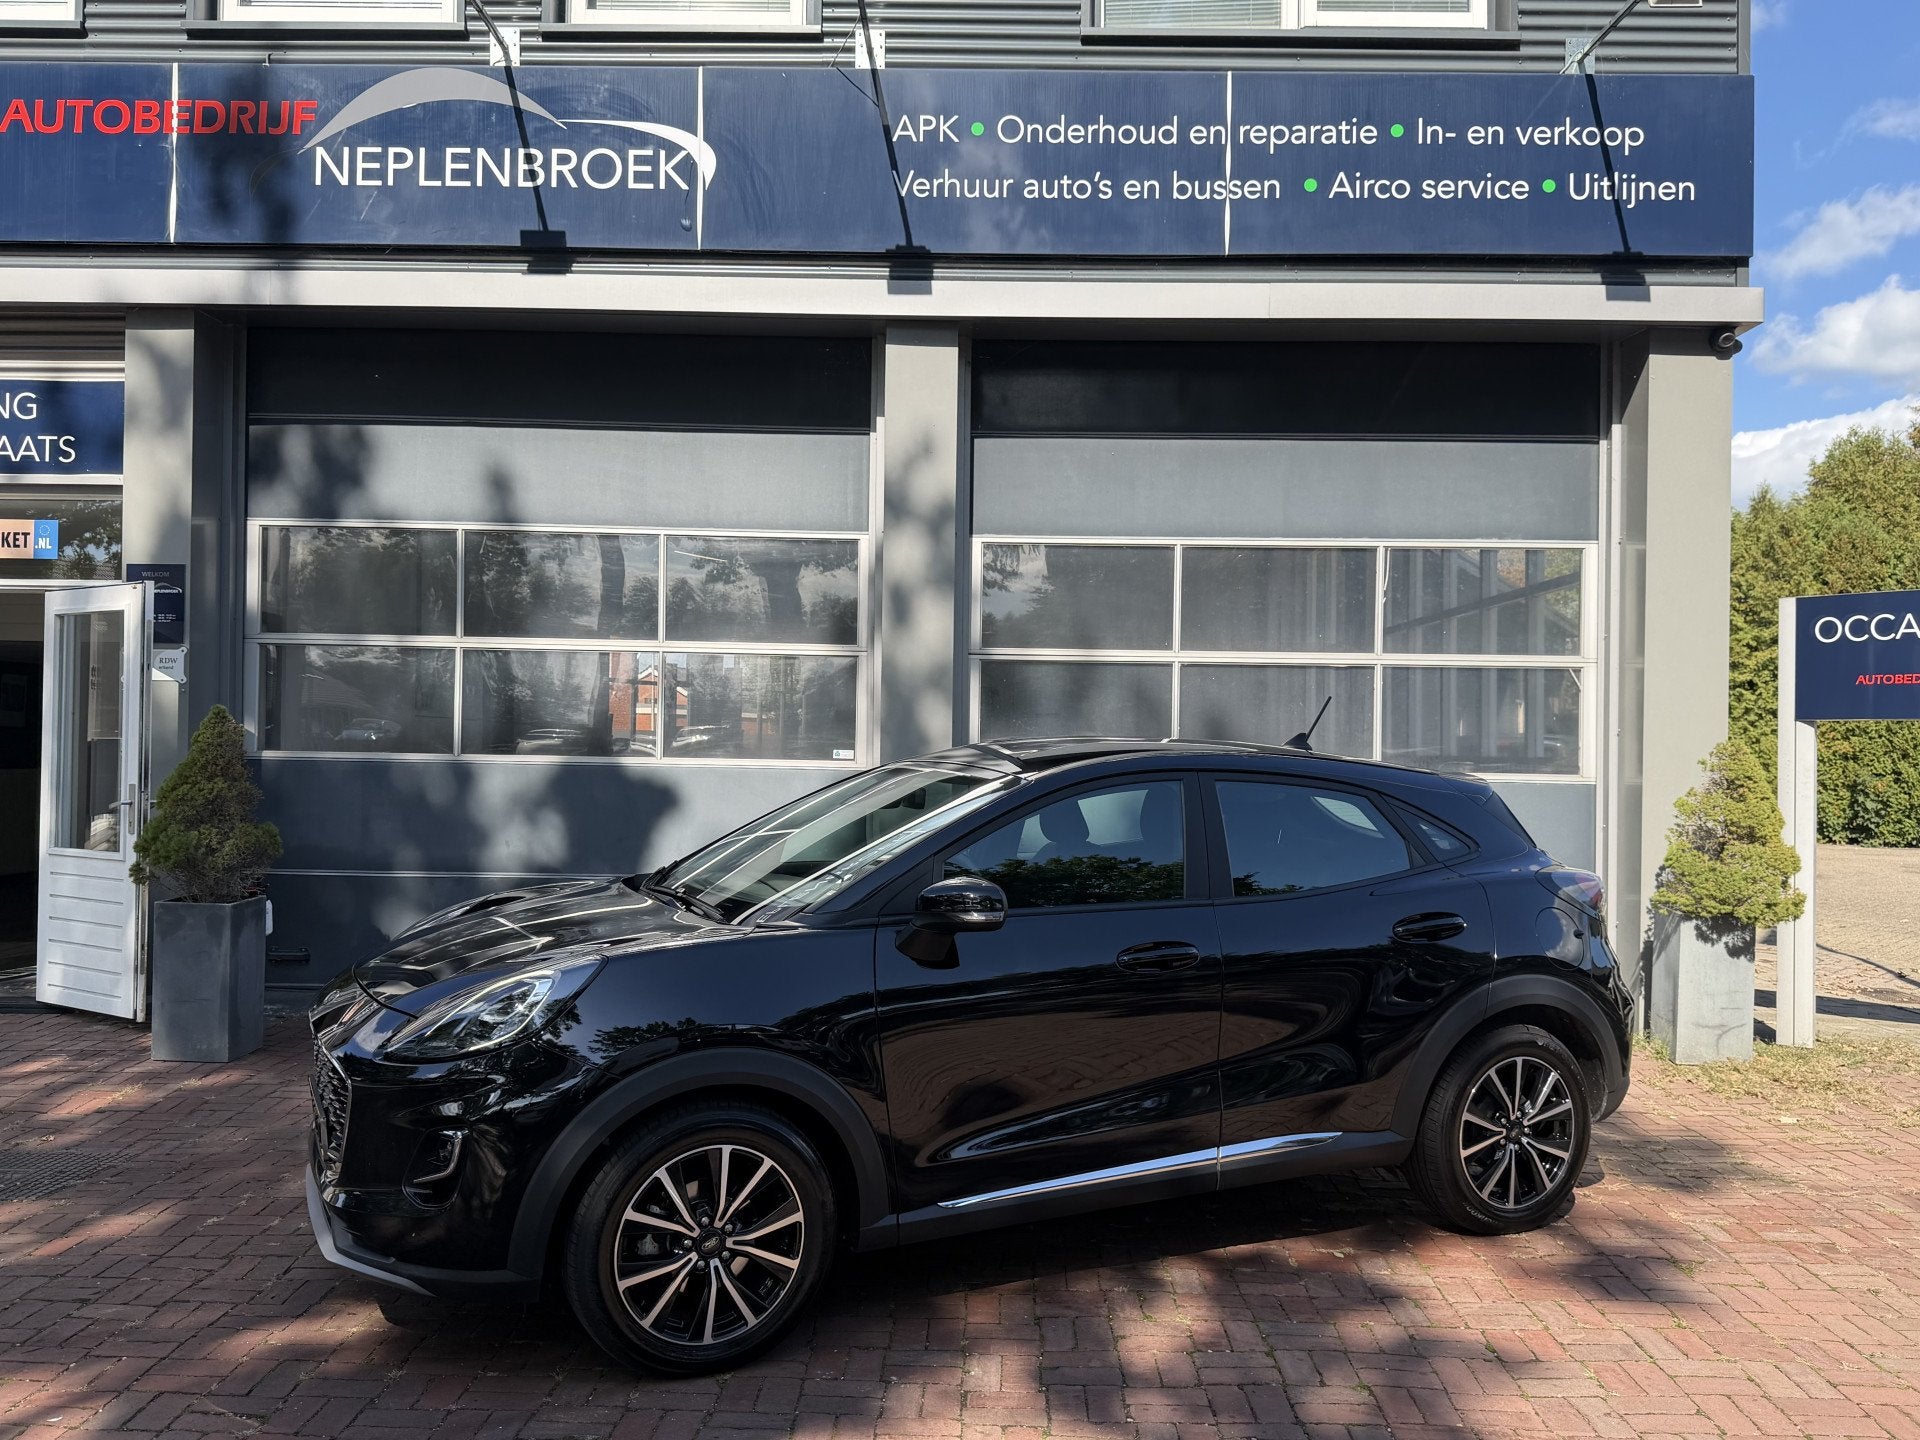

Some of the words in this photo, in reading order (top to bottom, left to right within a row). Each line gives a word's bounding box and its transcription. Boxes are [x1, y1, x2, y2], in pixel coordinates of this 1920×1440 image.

[0, 99, 318, 135] AUTOBEDRIJF
[892, 115, 960, 143] APK
[996, 114, 1178, 145] Onderhoud
[1189, 125, 1226, 145] en
[1239, 117, 1378, 155] reparatie
[1418, 117, 1457, 145] In-
[1467, 125, 1504, 146] en
[1515, 117, 1645, 156] verkoop
[314, 146, 691, 191] NEPLENBROEK
[892, 168, 1014, 199] Verhuur
[1123, 179, 1160, 200] en
[1172, 170, 1281, 200] bussen
[1328, 171, 1411, 199] Airco
[1421, 172, 1530, 200] service
[1569, 171, 1695, 209] Uitlijnen
[1814, 612, 1920, 644] OCCA
[159, 657, 179, 665] RDW
[1856, 673, 1920, 685] AUTOBED
